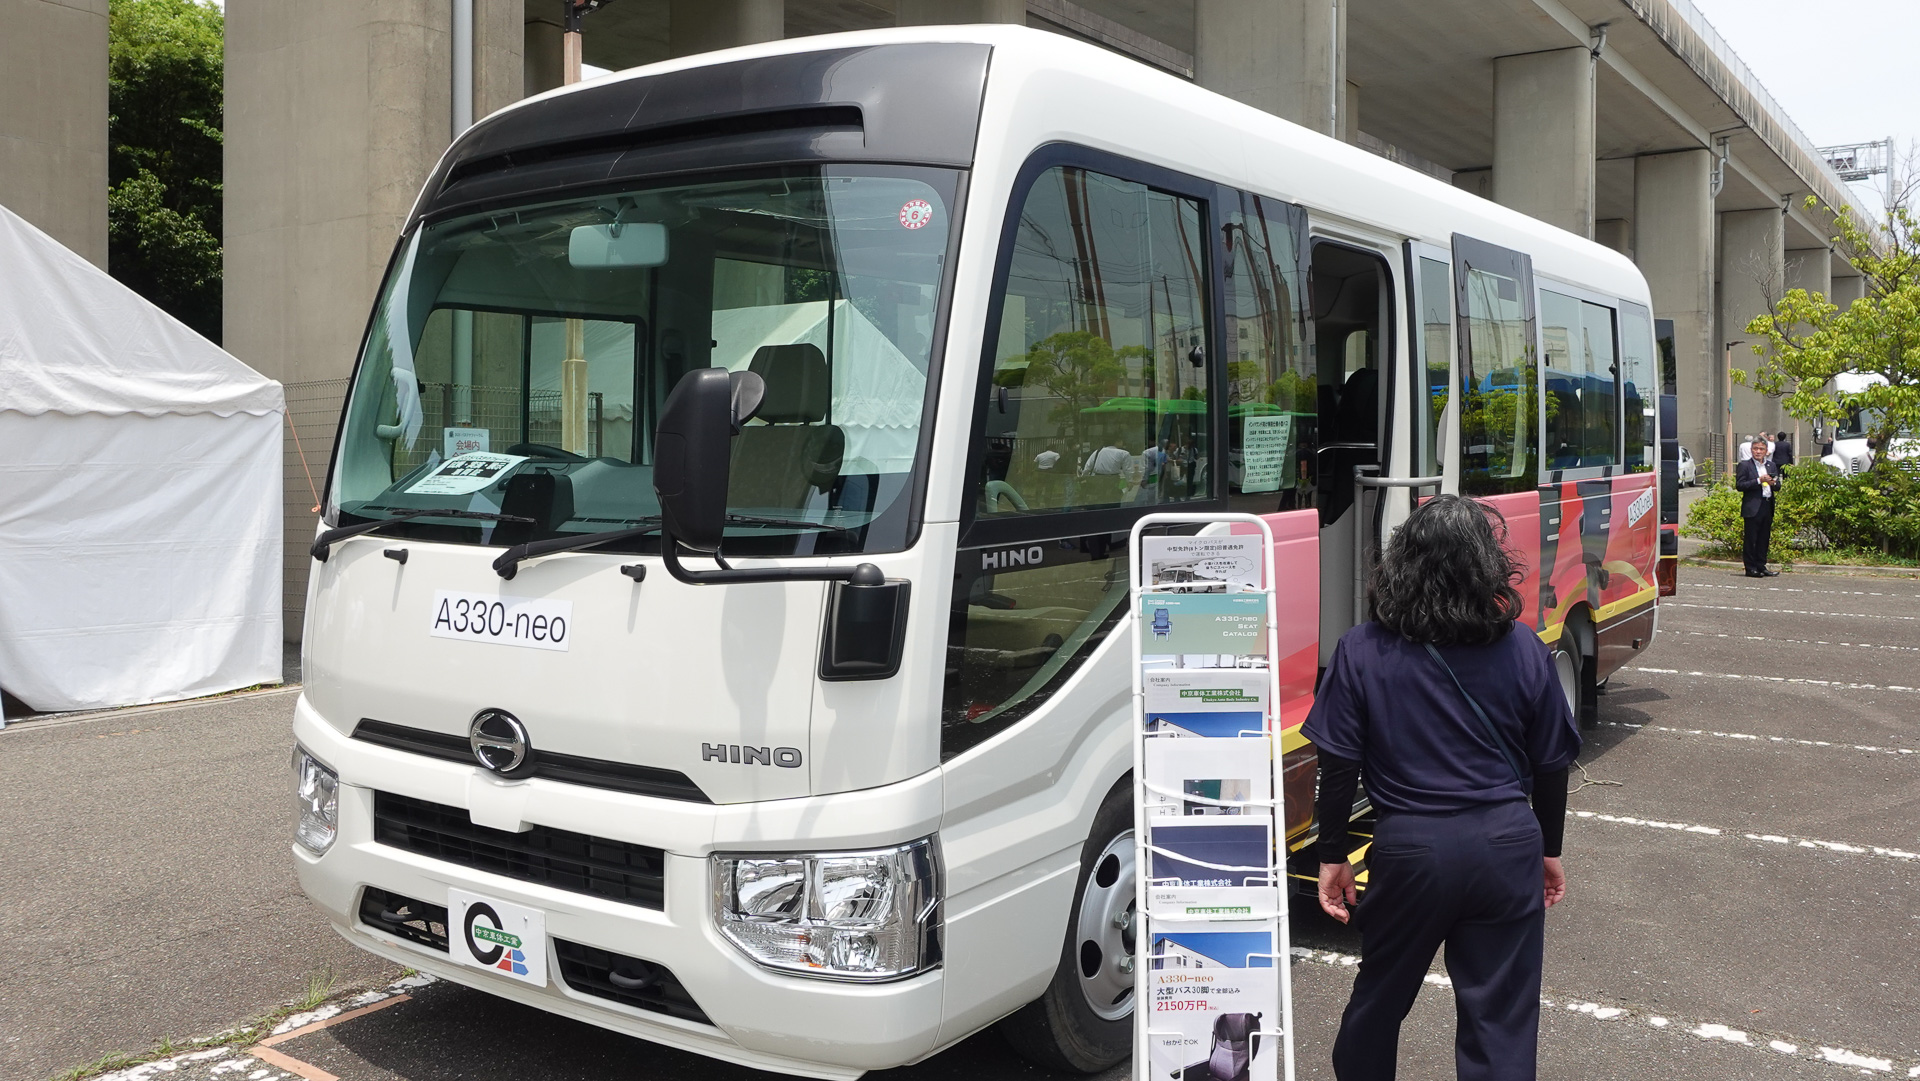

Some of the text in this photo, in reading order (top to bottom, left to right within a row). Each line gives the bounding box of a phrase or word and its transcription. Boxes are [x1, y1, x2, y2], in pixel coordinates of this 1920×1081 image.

[456, 440, 480, 451] 会場内
[1629, 492, 1653, 522] A330-neo
[982, 546, 1043, 570] HINO
[434, 597, 566, 643] A330-neo
[702, 743, 803, 769] HINO
[475, 927, 518, 947] 中京車体工業
[1157, 974, 1214, 985] A330-neo
[1156, 986, 1241, 996] 大型バス30脚で全部込み
[1156, 1000, 1207, 1011] 2150万円
